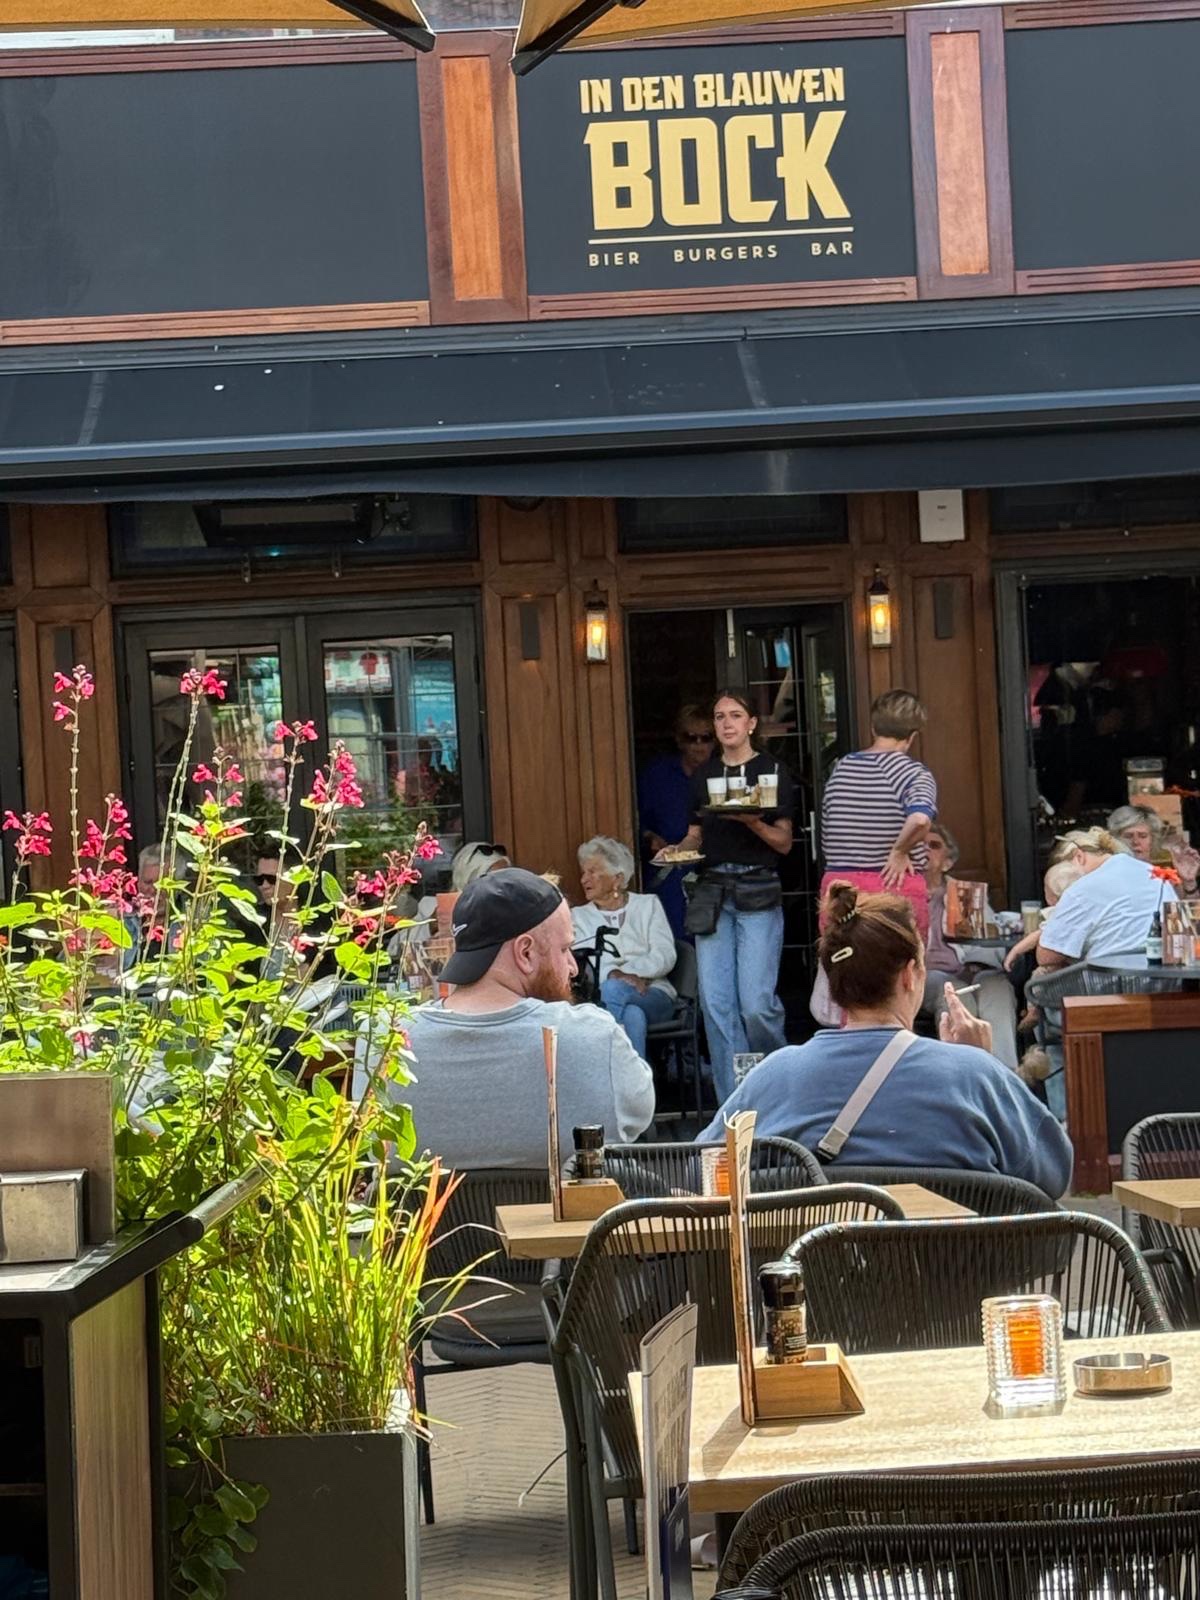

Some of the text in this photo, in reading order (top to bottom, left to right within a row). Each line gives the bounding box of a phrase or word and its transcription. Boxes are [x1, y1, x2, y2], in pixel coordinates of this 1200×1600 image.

[579, 67, 845, 114] IN DEN BLAUWEN
[583, 110, 851, 231] BOCK
[588, 241, 853, 267] BIER BURGERS BAR
